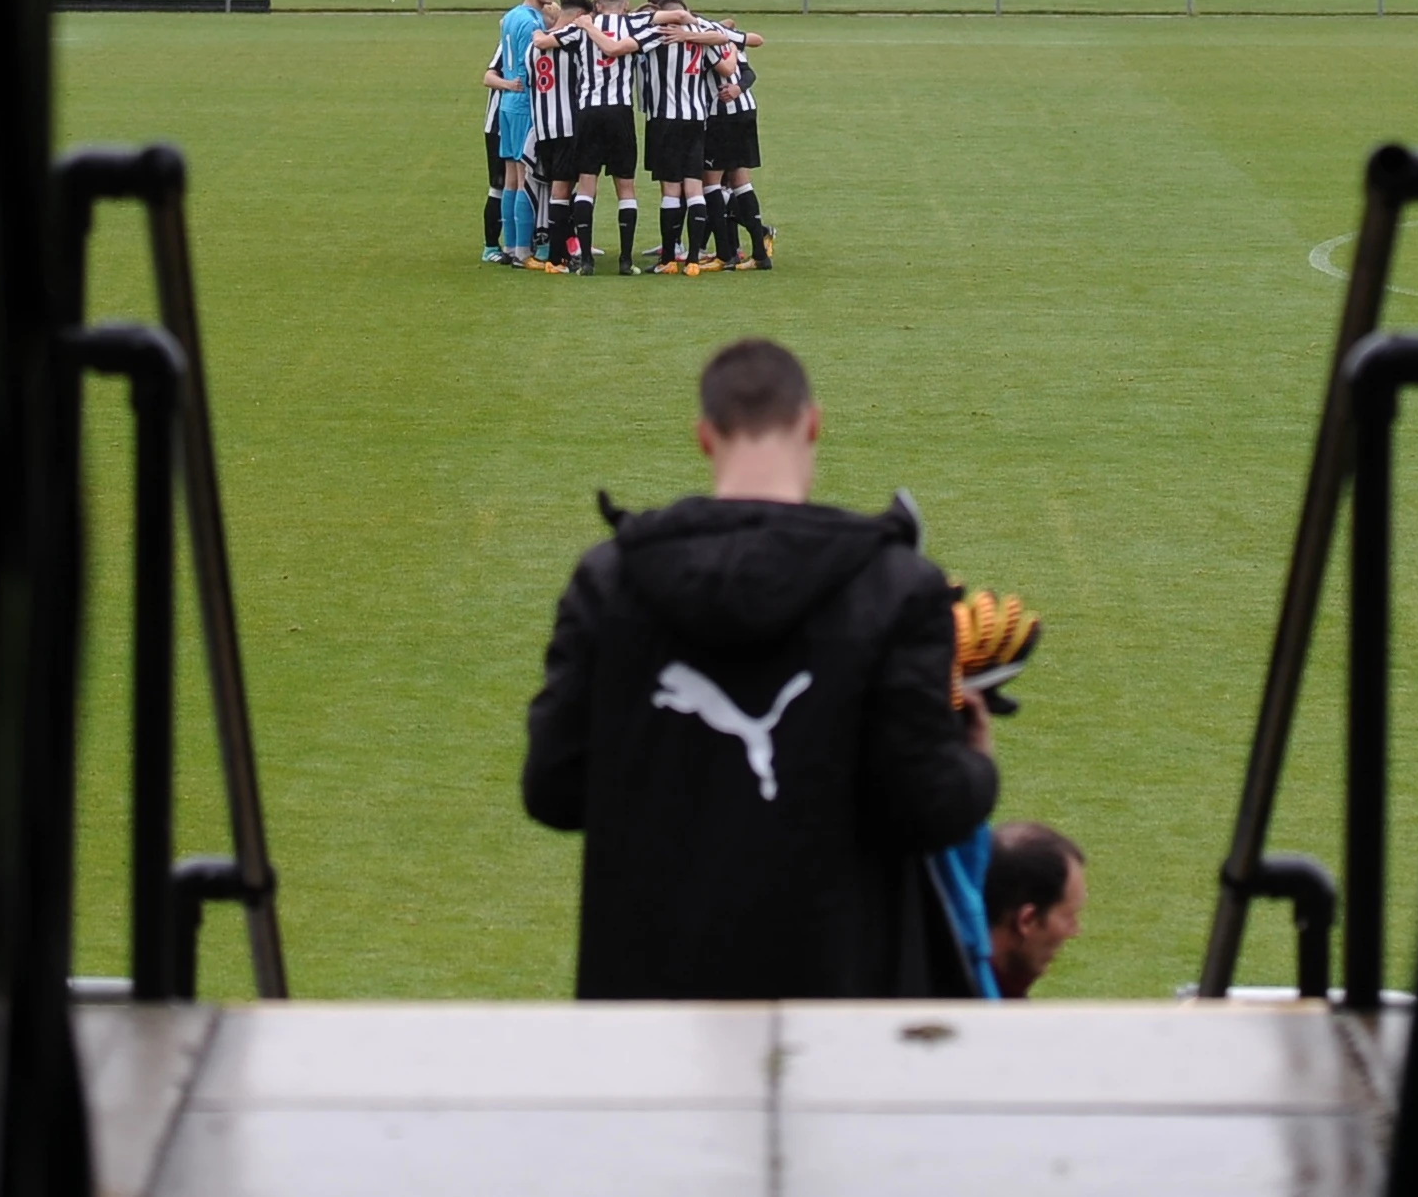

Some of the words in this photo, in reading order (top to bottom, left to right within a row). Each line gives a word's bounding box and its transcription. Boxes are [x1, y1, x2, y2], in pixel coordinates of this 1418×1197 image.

[505, 34, 513, 71] 1
[684, 42, 702, 75] 2
[536, 56, 555, 93] 8
